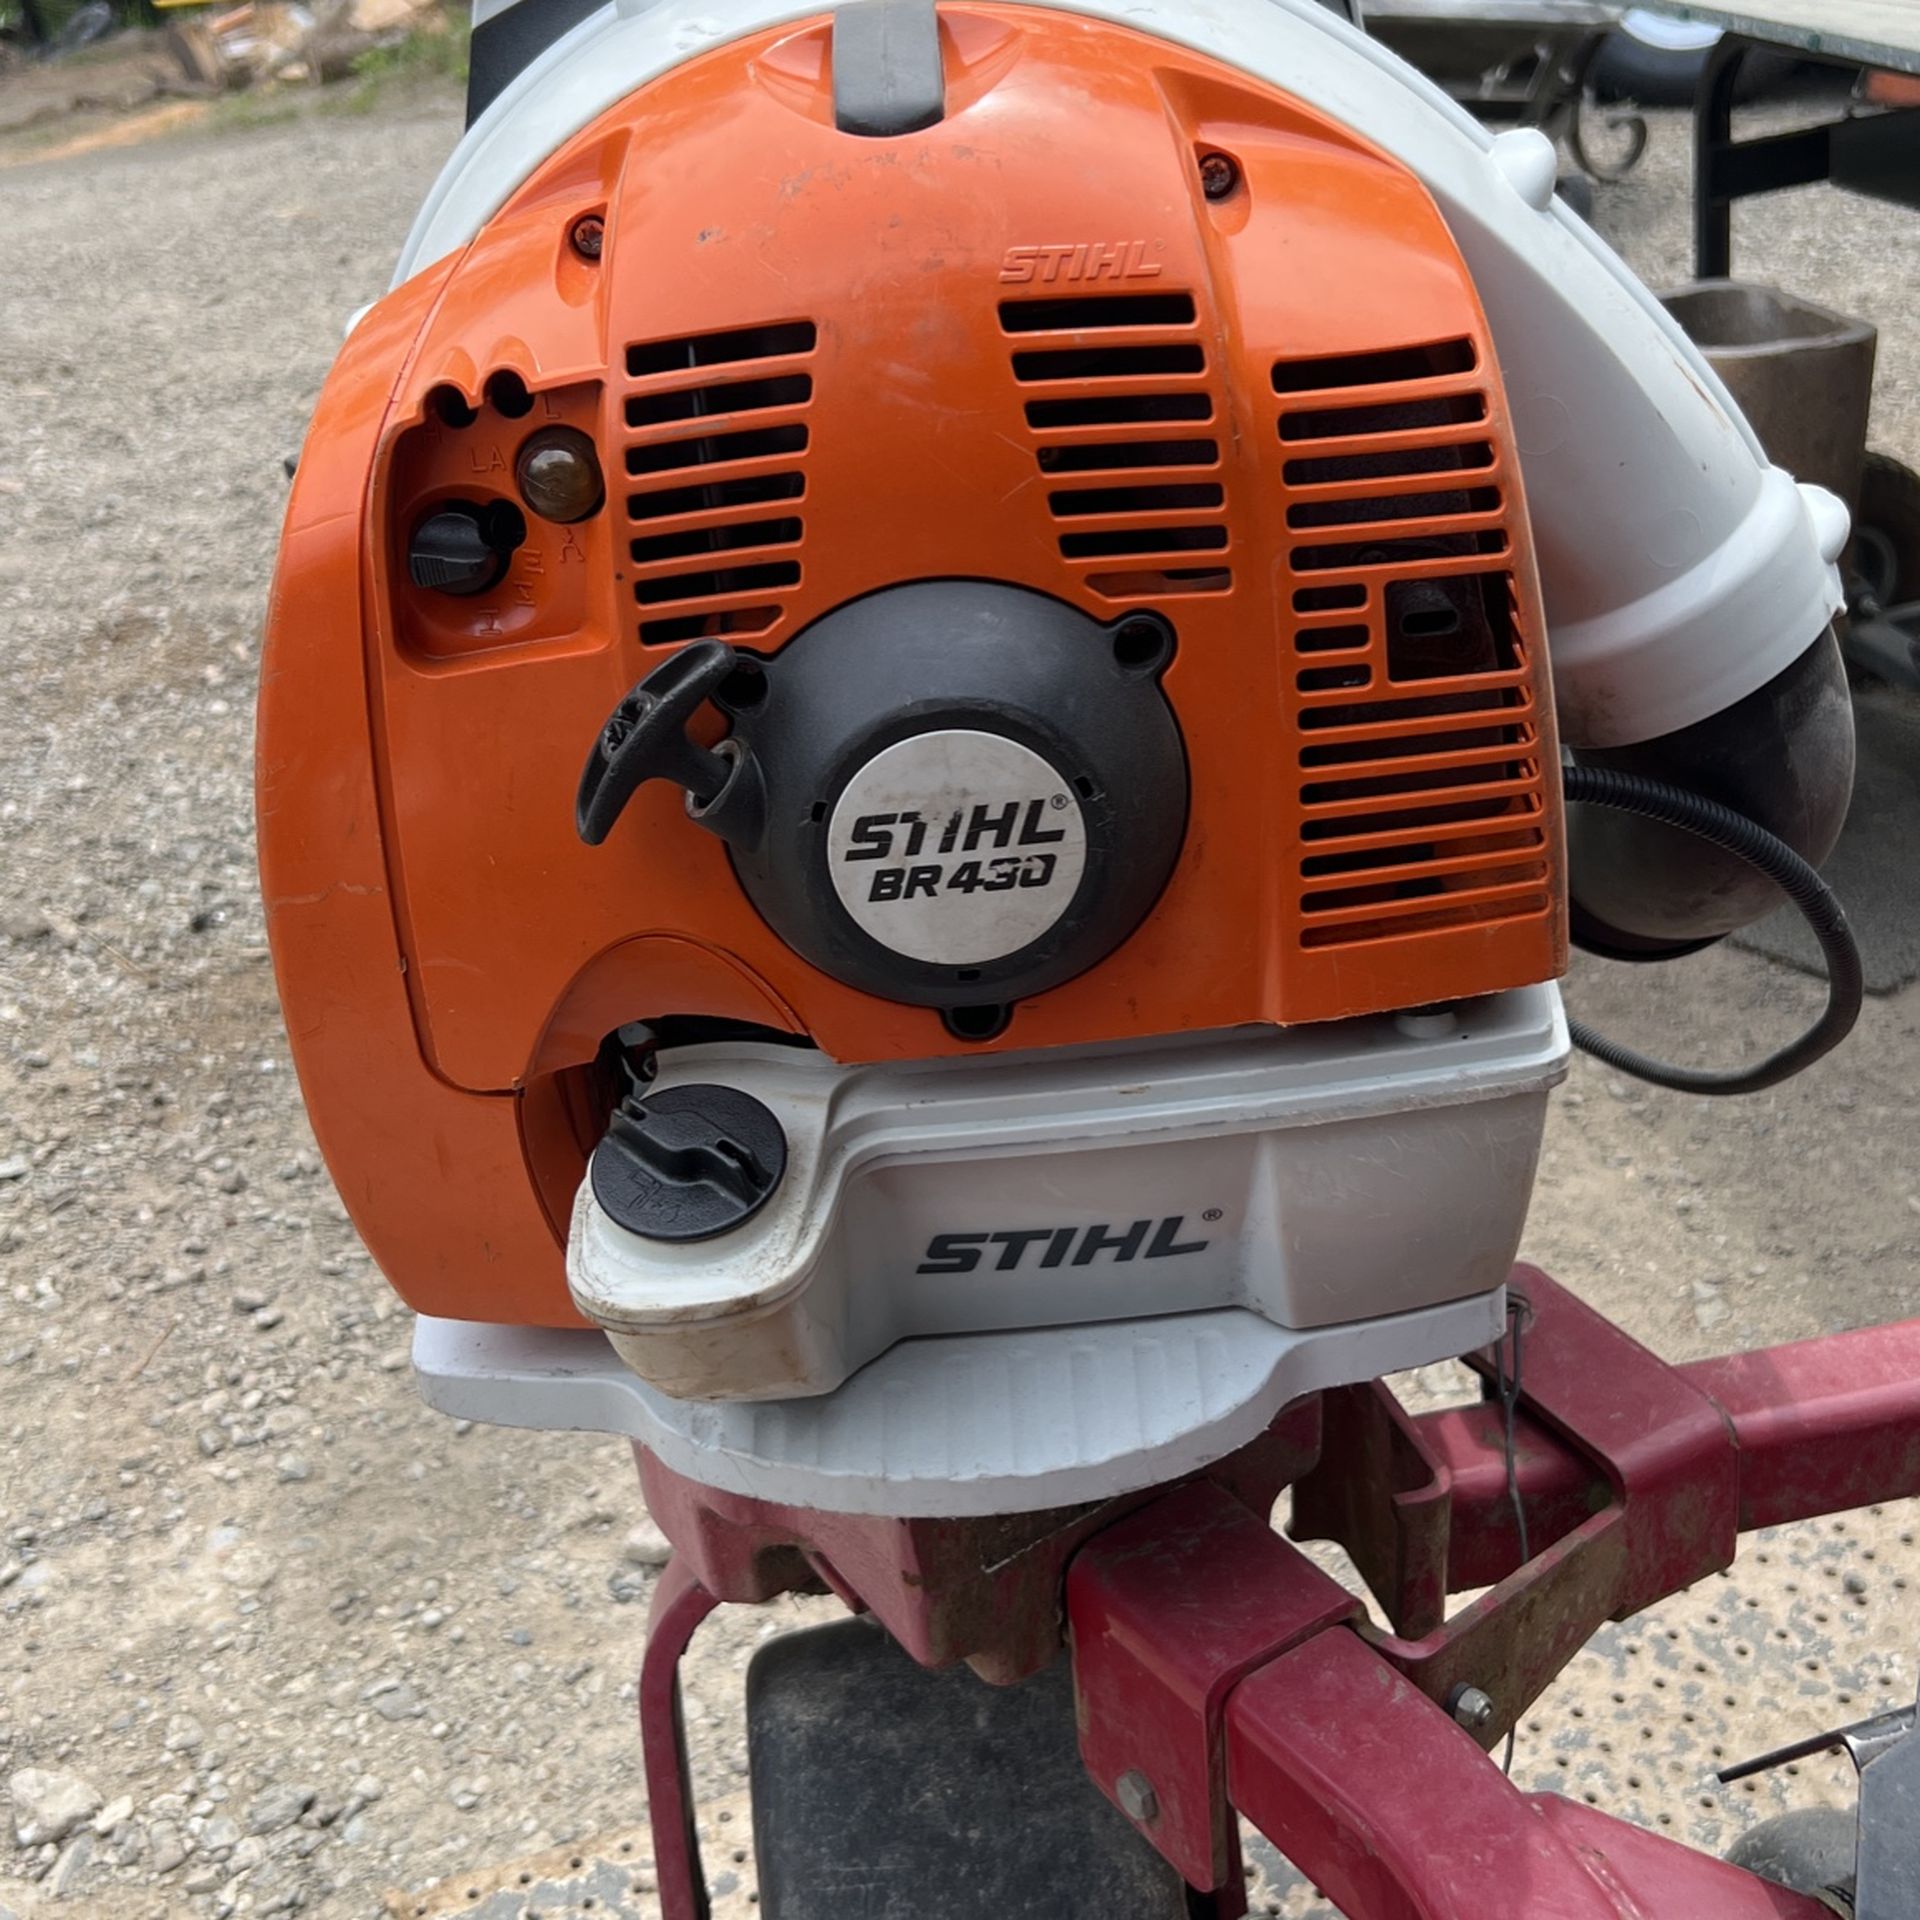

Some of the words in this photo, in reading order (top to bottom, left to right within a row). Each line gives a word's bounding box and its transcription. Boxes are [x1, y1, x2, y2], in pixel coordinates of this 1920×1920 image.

[998, 240, 1162, 284] STIHL
[470, 446, 507, 473] LA
[844, 799, 1066, 862] STIHL
[915, 1215, 1210, 1275] STIHL
